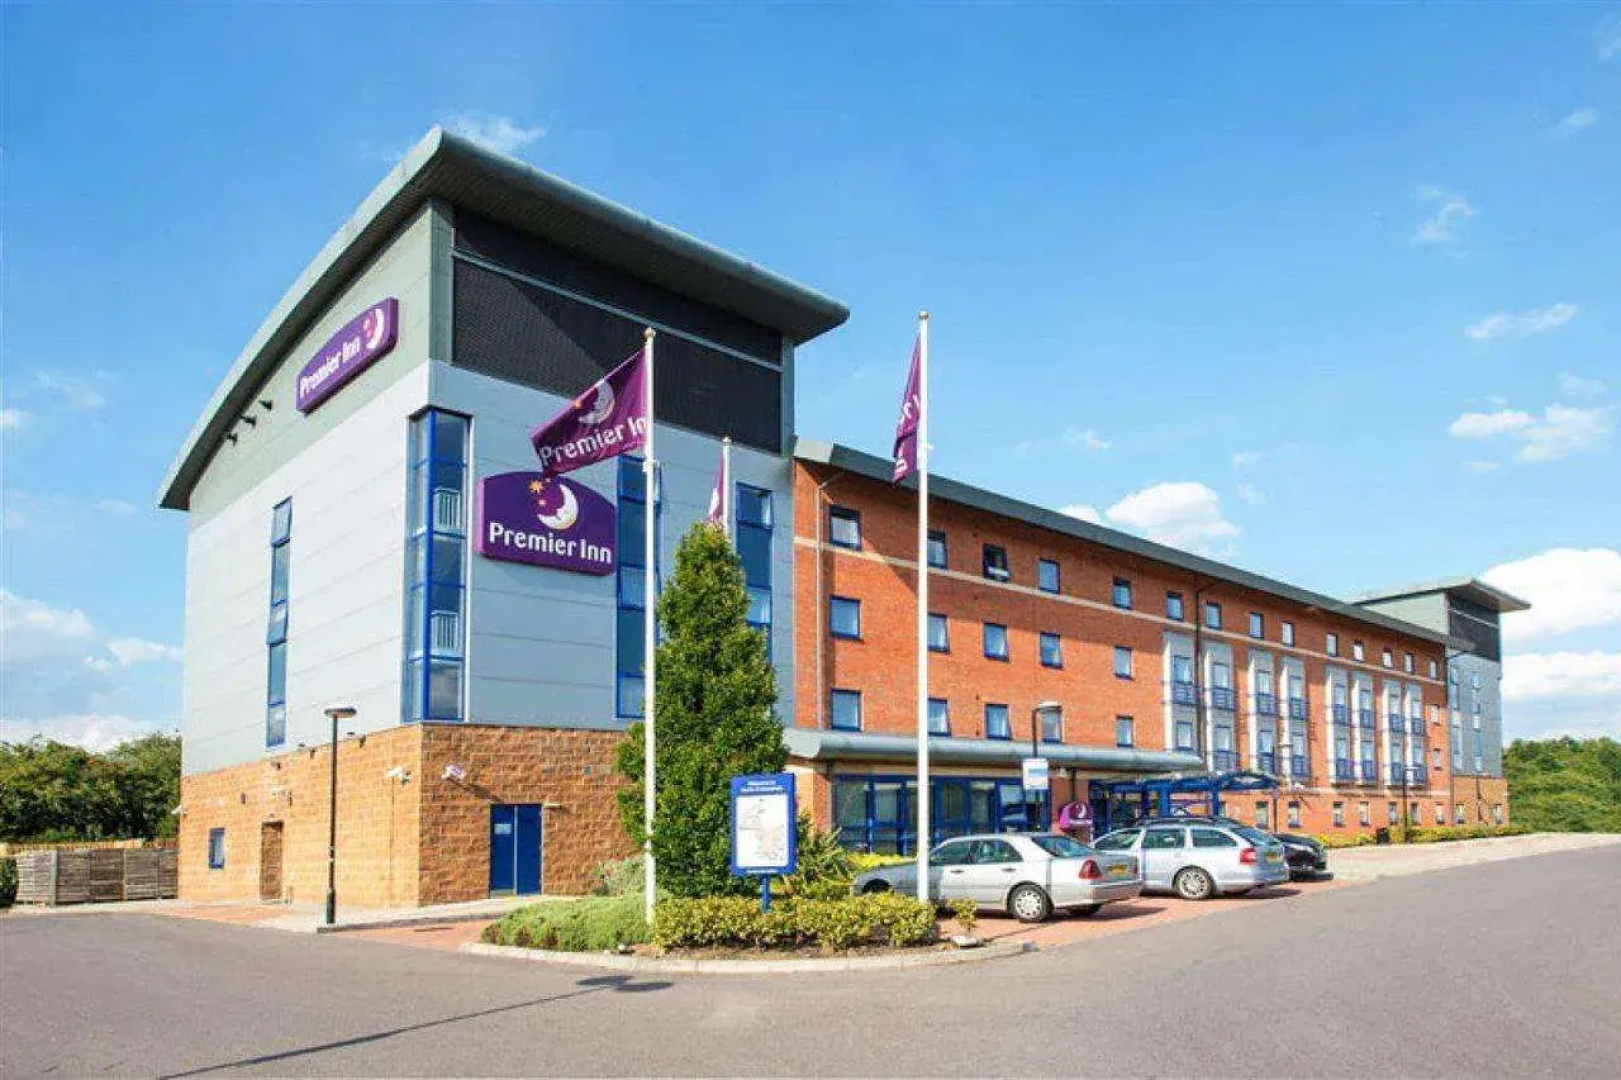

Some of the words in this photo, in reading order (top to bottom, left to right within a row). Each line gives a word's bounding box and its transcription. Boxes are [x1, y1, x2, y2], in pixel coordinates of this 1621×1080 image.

[540, 424, 624, 466] Premier
[489, 522, 577, 557] Premier
[580, 539, 612, 564] Inn
